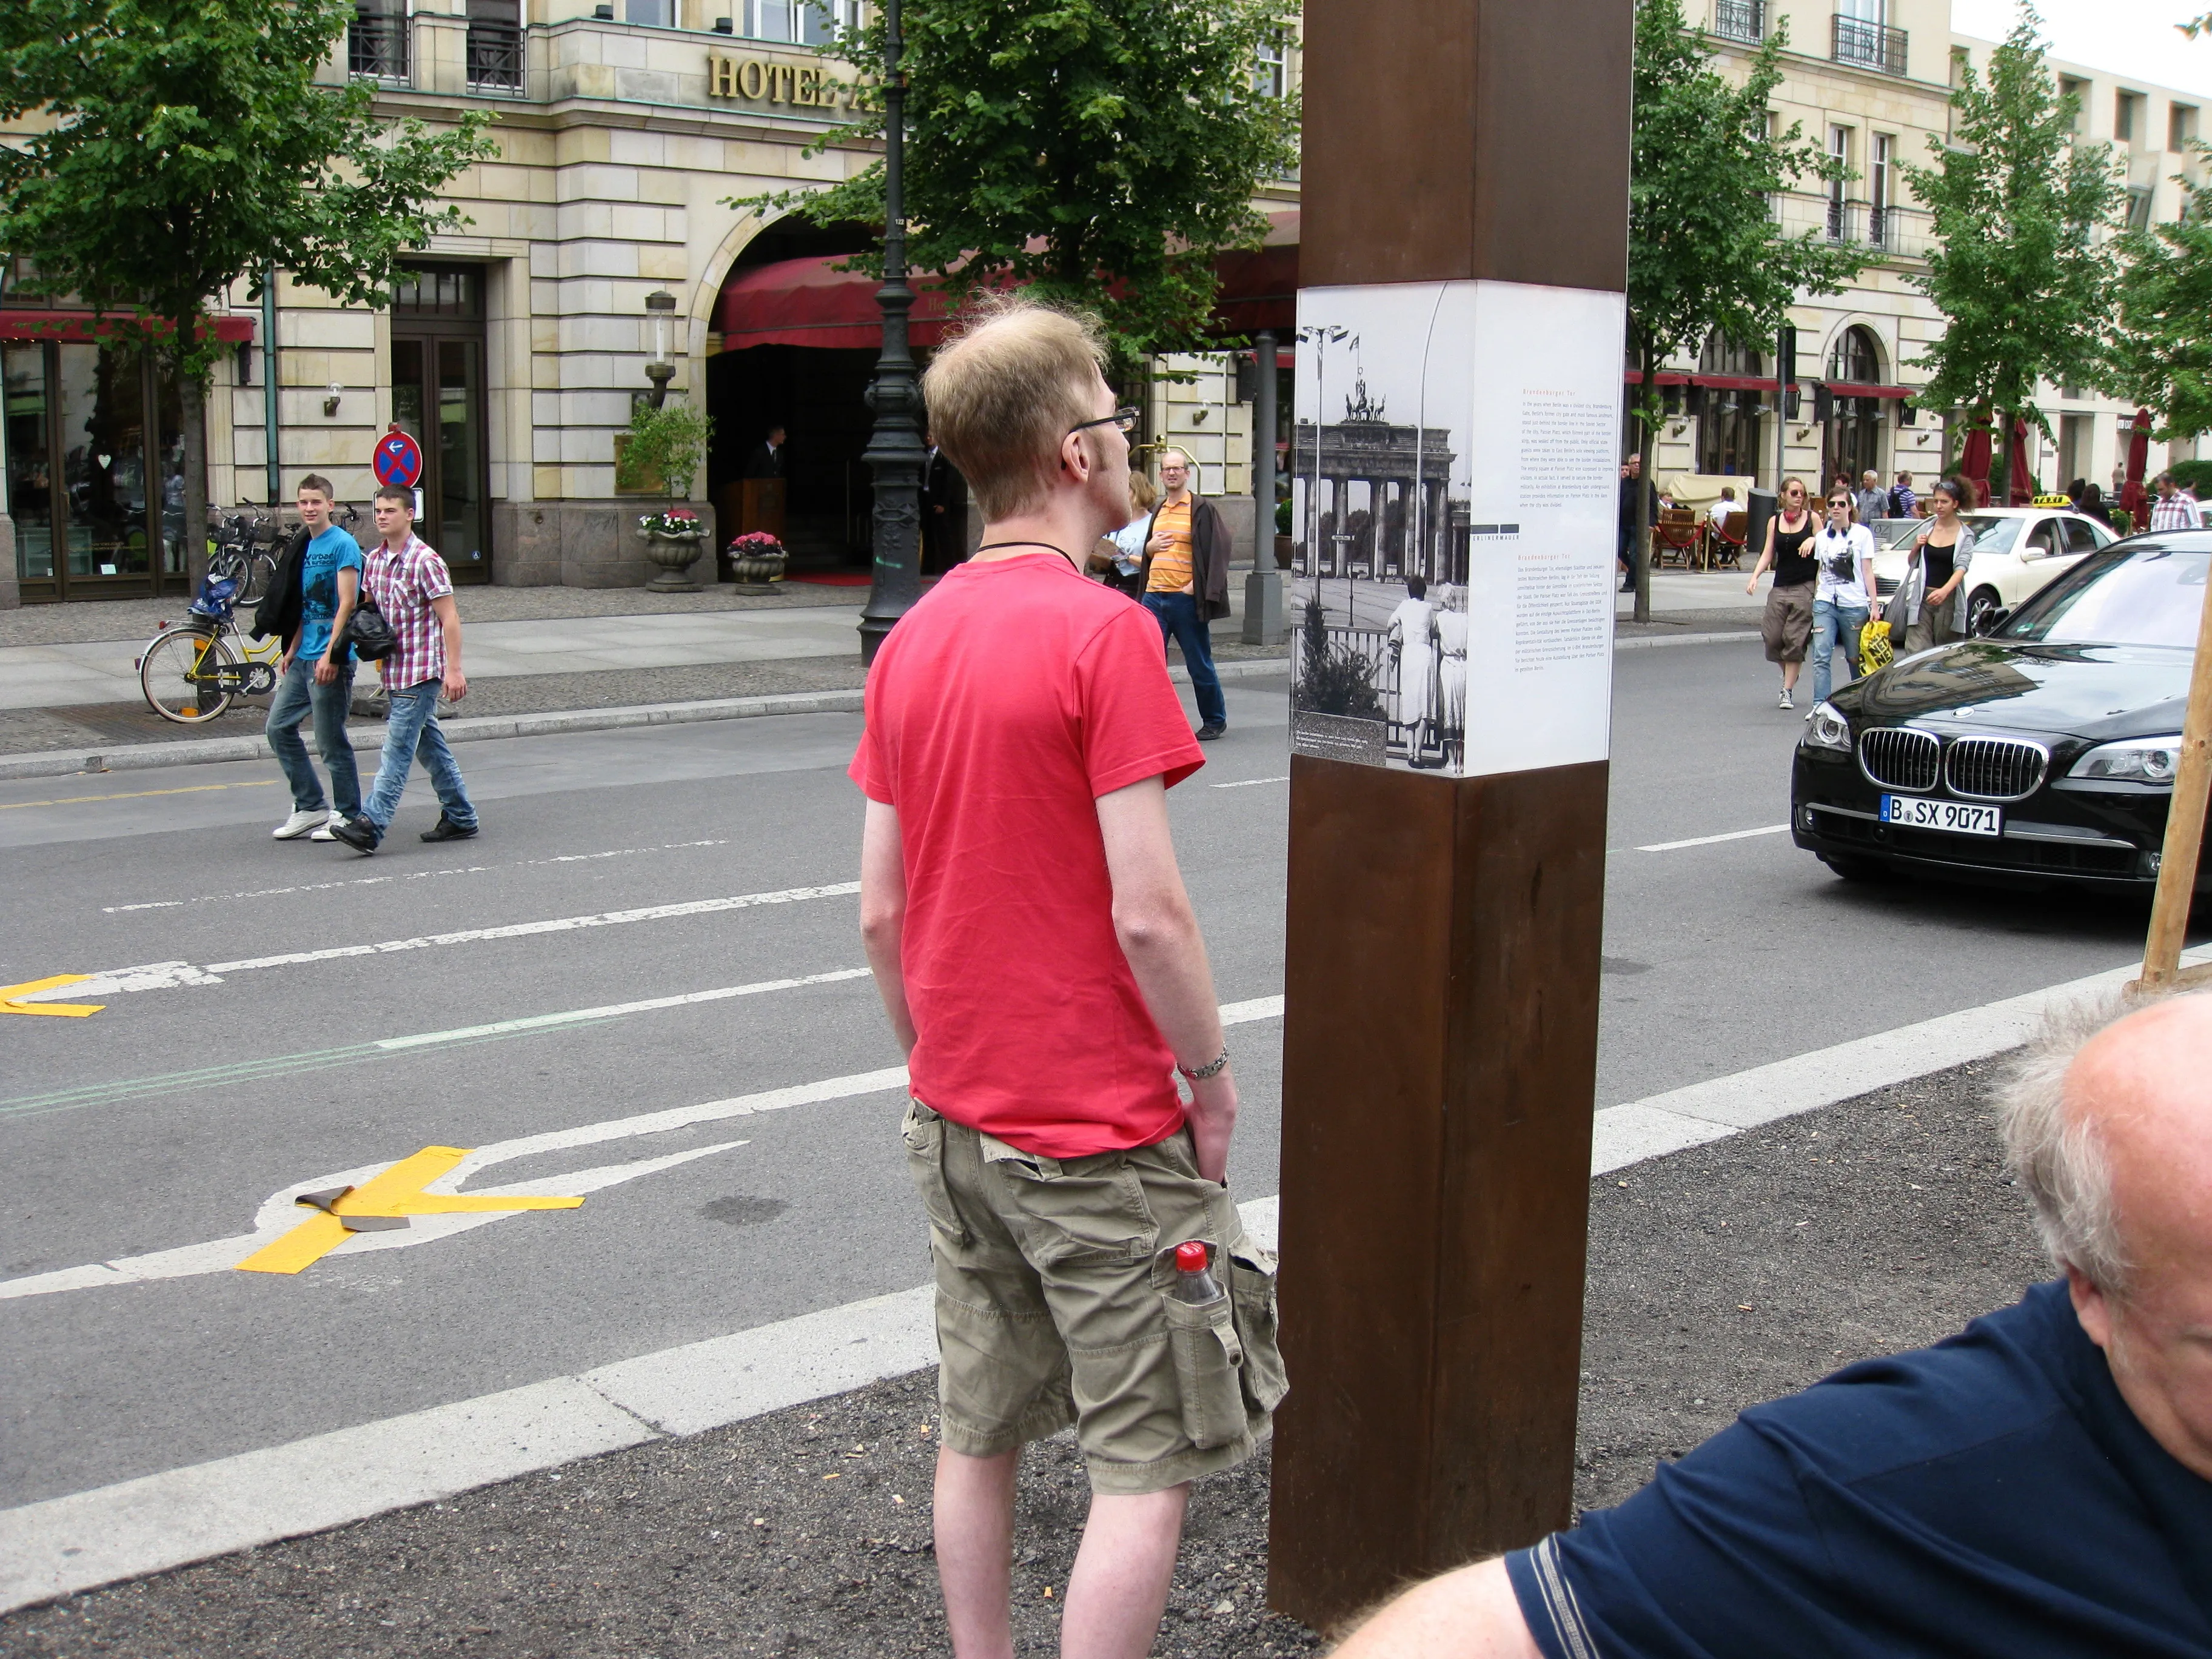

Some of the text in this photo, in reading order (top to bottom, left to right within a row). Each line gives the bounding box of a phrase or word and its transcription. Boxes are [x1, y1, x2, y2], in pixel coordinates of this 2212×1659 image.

[710, 56, 838, 108] HOTEL
[1891, 799, 1902, 820] B
[1915, 802, 1939, 825] SX
[1945, 806, 1996, 832] 9071
